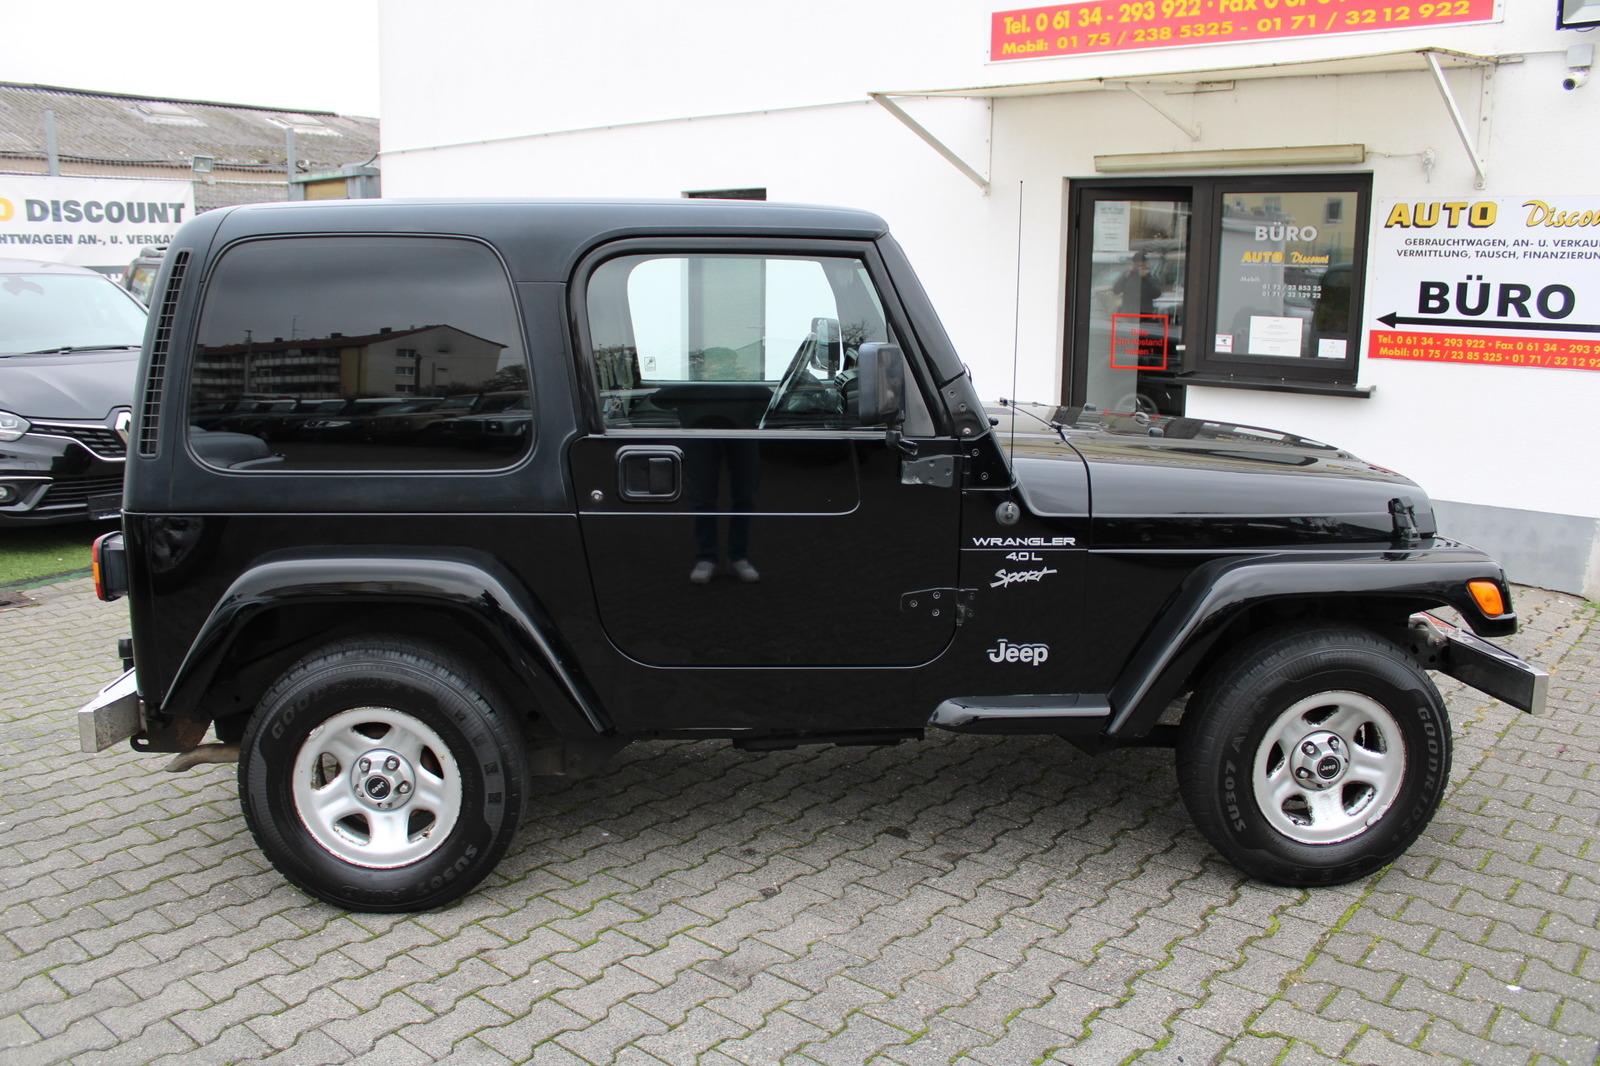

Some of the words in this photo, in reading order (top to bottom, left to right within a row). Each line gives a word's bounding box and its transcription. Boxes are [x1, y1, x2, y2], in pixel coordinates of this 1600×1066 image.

[1004, 15, 1030, 34] Tel.
[1036, 13, 1048, 31] 0
[1053, 10, 1070, 29] 61
[1078, 7, 1102, 27] 34
[1119, 2, 1155, 22] 293
[1161, 0, 1201, 18] 922
[1002, 40, 1048, 54] Mobil:
[1057, 36, 1077, 49] 01
[1088, 33, 1111, 46] 75
[1134, 27, 1172, 42] 238
[1180, 21, 1233, 38] 5325
[1257, 18, 1281, 32] 01
[1291, 15, 1315, 29] 71
[1345, 10, 1376, 24] 32
[1384, 6, 1410, 21] 12
[1419, 0, 1469, 17] 922
[25, 199, 185, 223] DISCOUNT
[1384, 201, 1498, 229] AUTO
[126, 234, 174, 245] VERKA
[1255, 222, 1318, 242] BÜRO
[1404, 237, 1509, 249] GEBRAUCHTWAGEN,
[1512, 238, 1534, 248] AN-
[1538, 239, 1549, 249] U.
[1552, 239, 1600, 249] VERKAU
[1241, 250, 1284, 264] AUTO
[1396, 248, 1471, 259] VERMITTLUNG,
[1475, 250, 1519, 261] TAUSCH,
[1312, 292, 1323, 300] 22
[1313, 285, 1323, 293] 25
[1417, 275, 1576, 320] BÜRO
[1378, 335, 1393, 343] Tel.
[1397, 336, 1403, 344] 0
[1406, 336, 1417, 344] 61
[1421, 337, 1434, 345] 34
[1444, 338, 1463, 347] 293
[1466, 339, 1485, 348] 922
[1495, 341, 1513, 350] Fax
[1517, 342, 1523, 350] 0
[1526, 343, 1539, 351] 61
[1543, 343, 1557, 352] 34
[1569, 344, 1590, 354] 293
[1380, 347, 1409, 356] Mobil:
[1429, 350, 1440, 358] 75
[1451, 351, 1463, 359] 23
[1467, 352, 1479, 360] 85
[1483, 352, 1502, 361] 325
[1512, 354, 1524, 363] 01
[1529, 355, 1541, 364] 71
[1554, 357, 1568, 365] 32
[1573, 357, 1585, 366] 12
[973, 537, 1076, 546] WRANGLER
[990, 567, 1057, 587] Sport
[987, 638, 1050, 666] Jeep
[1224, 760, 1247, 833] SU307
